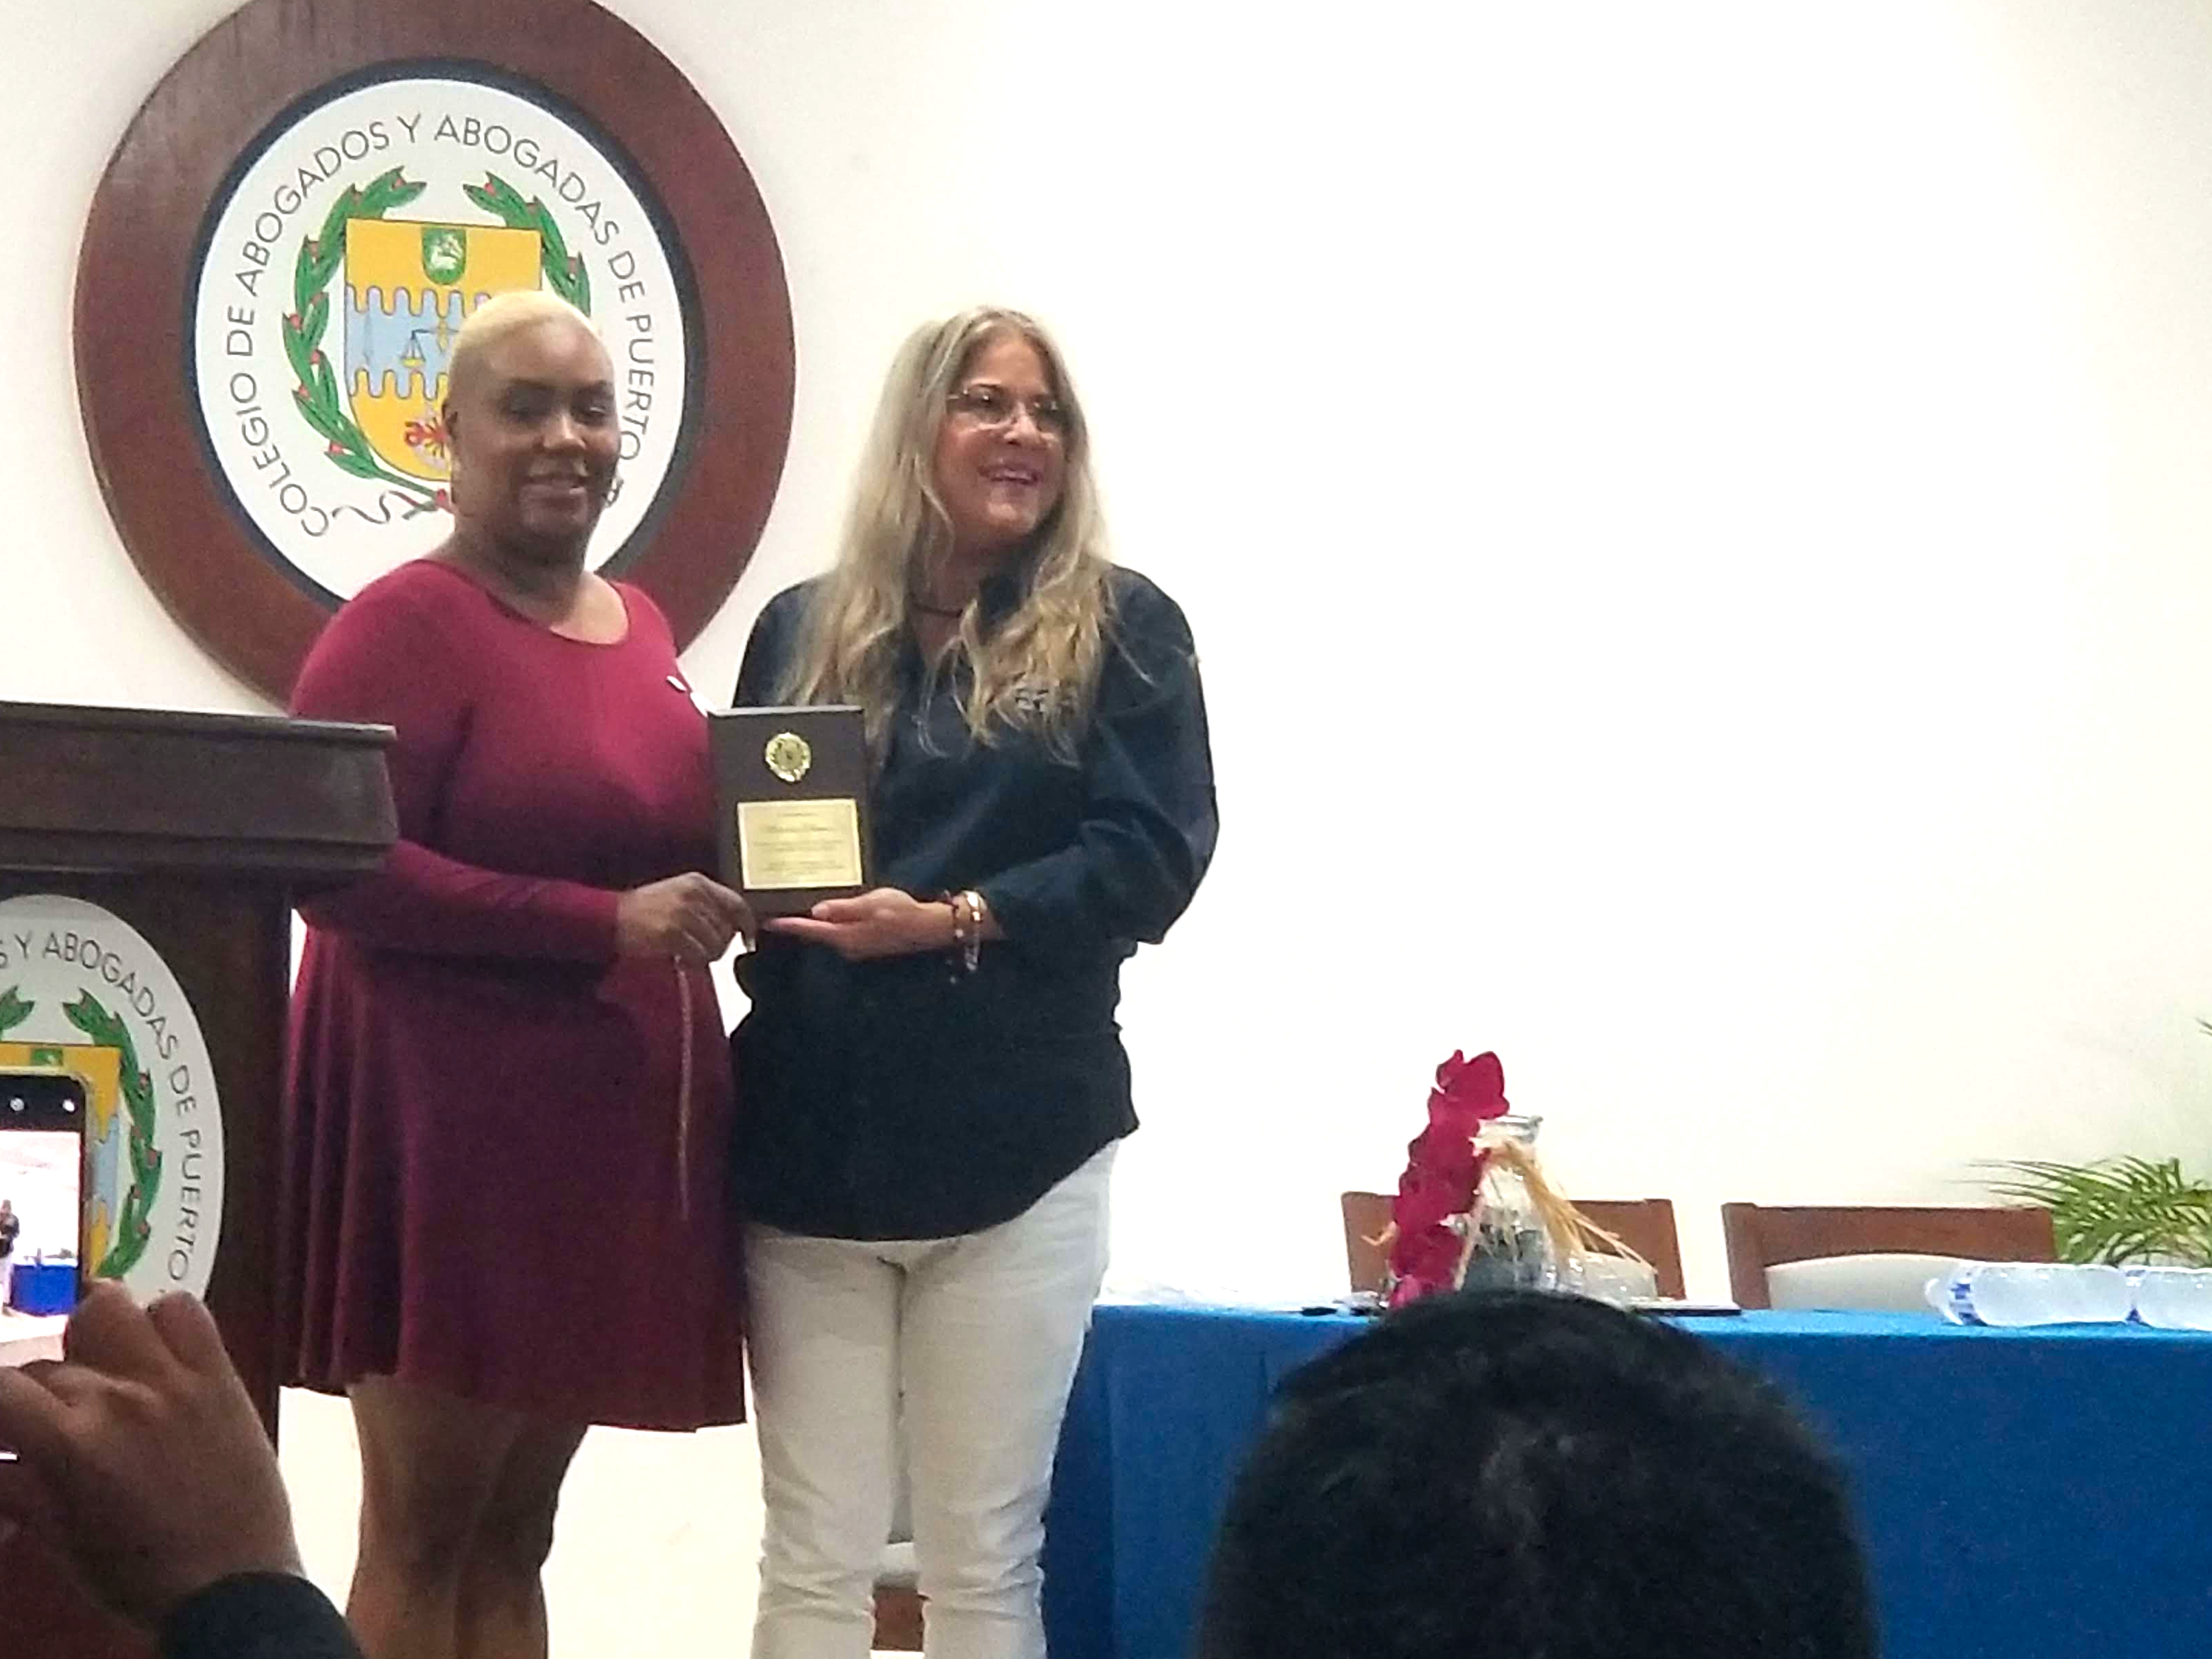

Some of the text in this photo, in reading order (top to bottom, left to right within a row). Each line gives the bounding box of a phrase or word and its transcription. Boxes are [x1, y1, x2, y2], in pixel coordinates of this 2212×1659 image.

[227, 114, 655, 537] COLEGIO DE ABOGADOS Y ABOGADAS DE PUERTO
[14, 930, 202, 1281] Y ABOGADAS DE PUERTO
